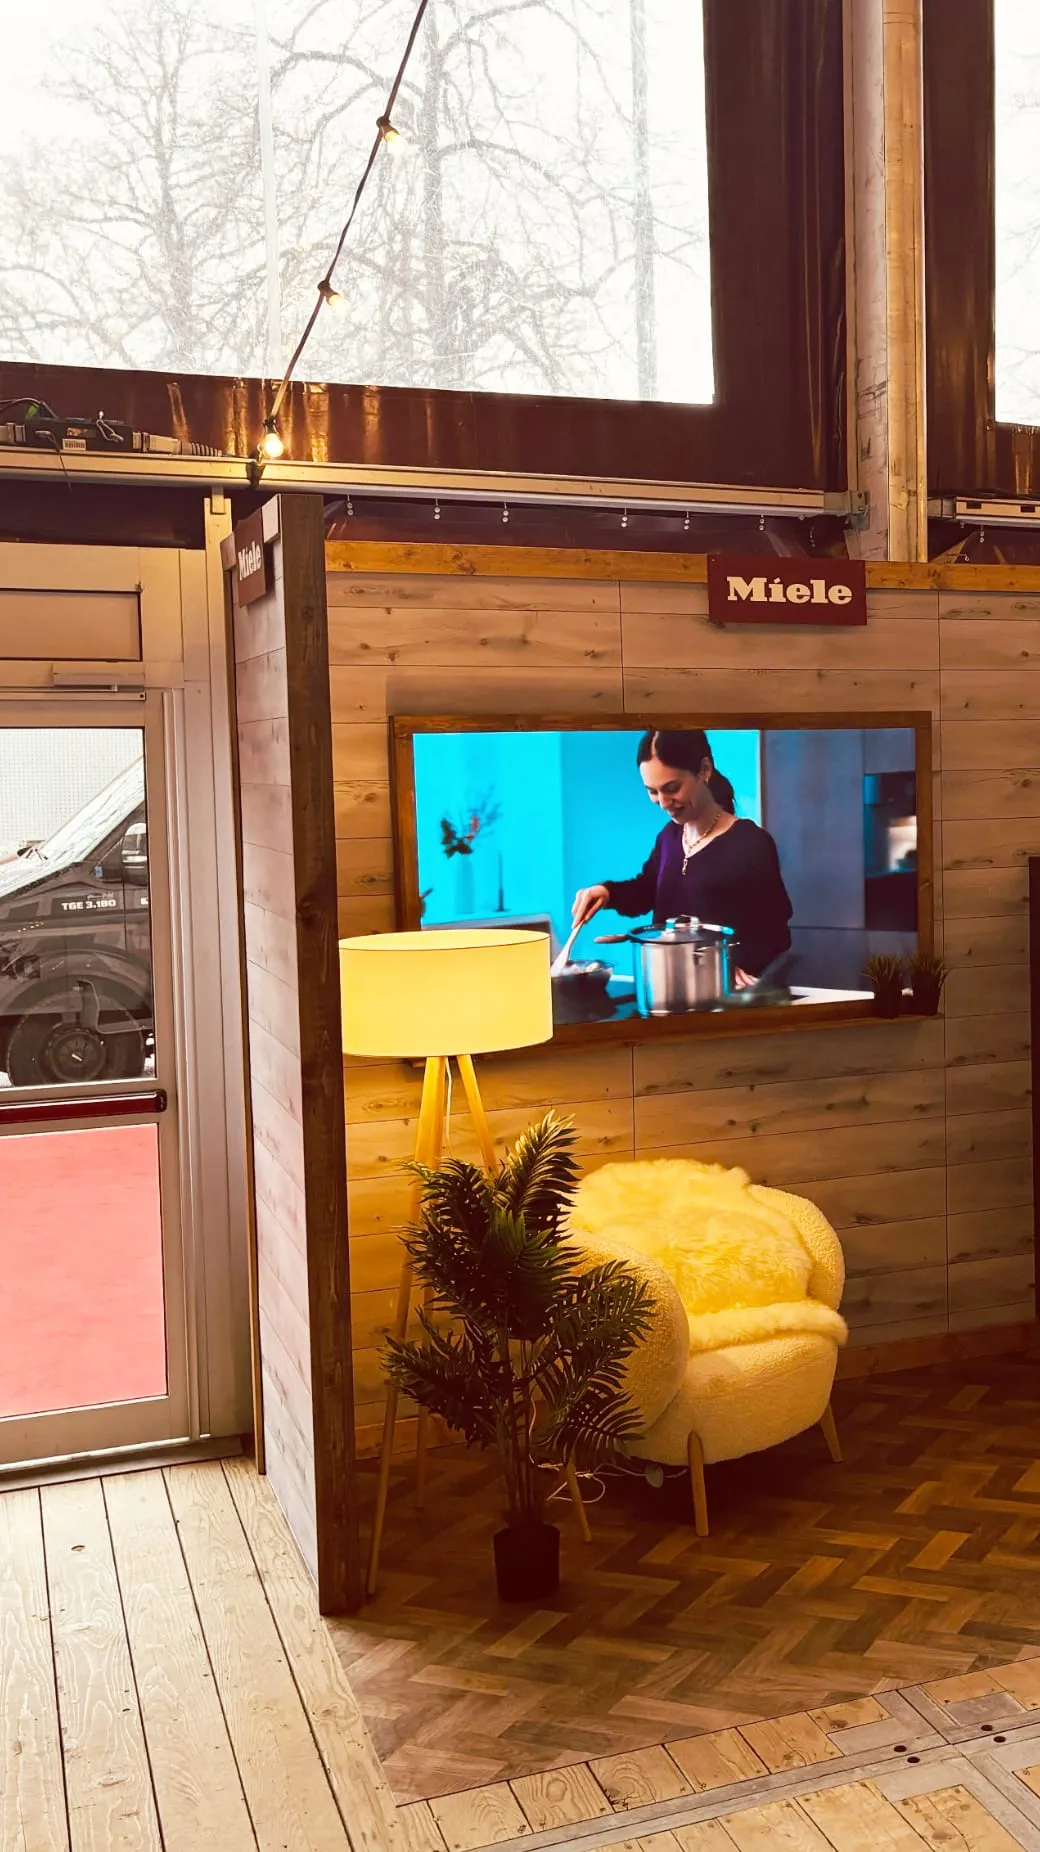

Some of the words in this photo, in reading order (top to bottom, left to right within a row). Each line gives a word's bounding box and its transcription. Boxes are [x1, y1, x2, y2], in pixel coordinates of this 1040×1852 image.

[237, 540, 262, 581] Miele
[726, 576, 853, 605] Miele
[61, 901, 84, 911] TGE
[85, 899, 117, 909] 3.180
